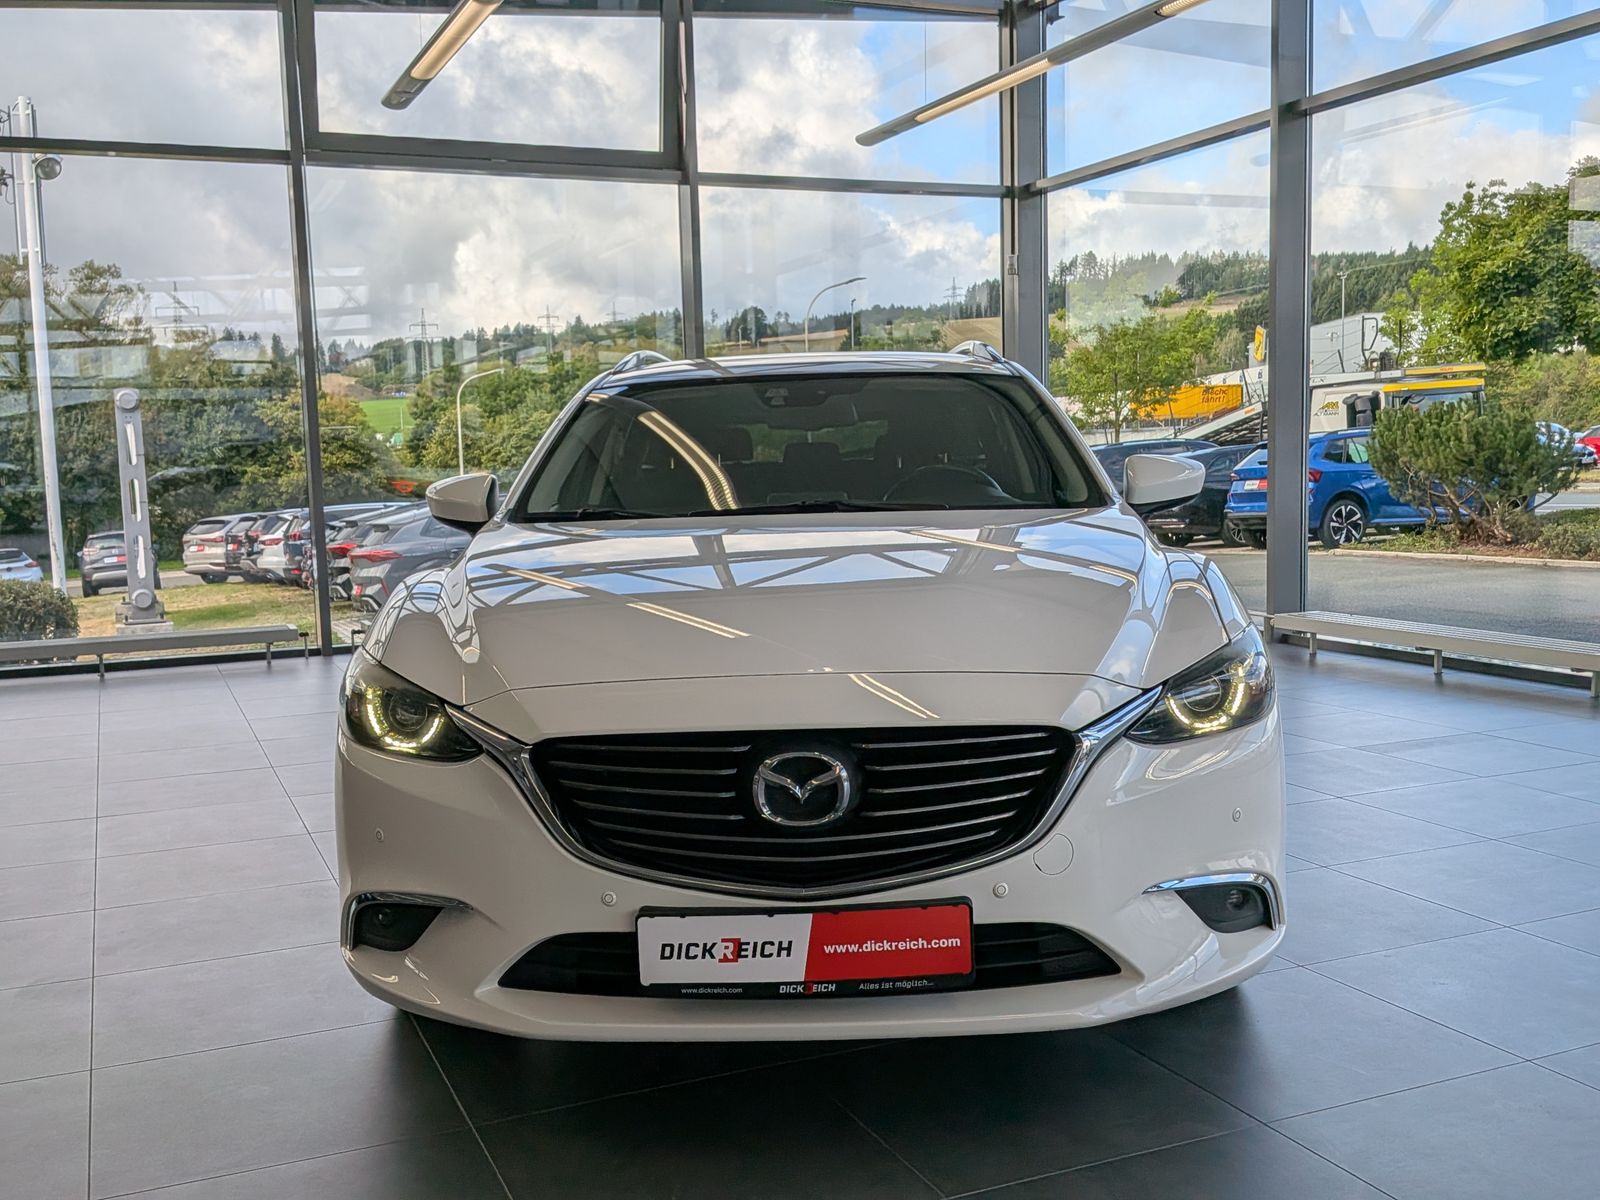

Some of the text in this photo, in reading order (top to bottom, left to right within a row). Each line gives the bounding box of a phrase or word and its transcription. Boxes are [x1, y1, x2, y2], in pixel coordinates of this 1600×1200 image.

[659, 938, 793, 963] DICKREICH
[823, 936, 961, 954] www.dickreich.com
[681, 986, 743, 994] www.dickreich.com
[859, 982, 880, 991] Alles
[881, 981, 894, 989] ist
